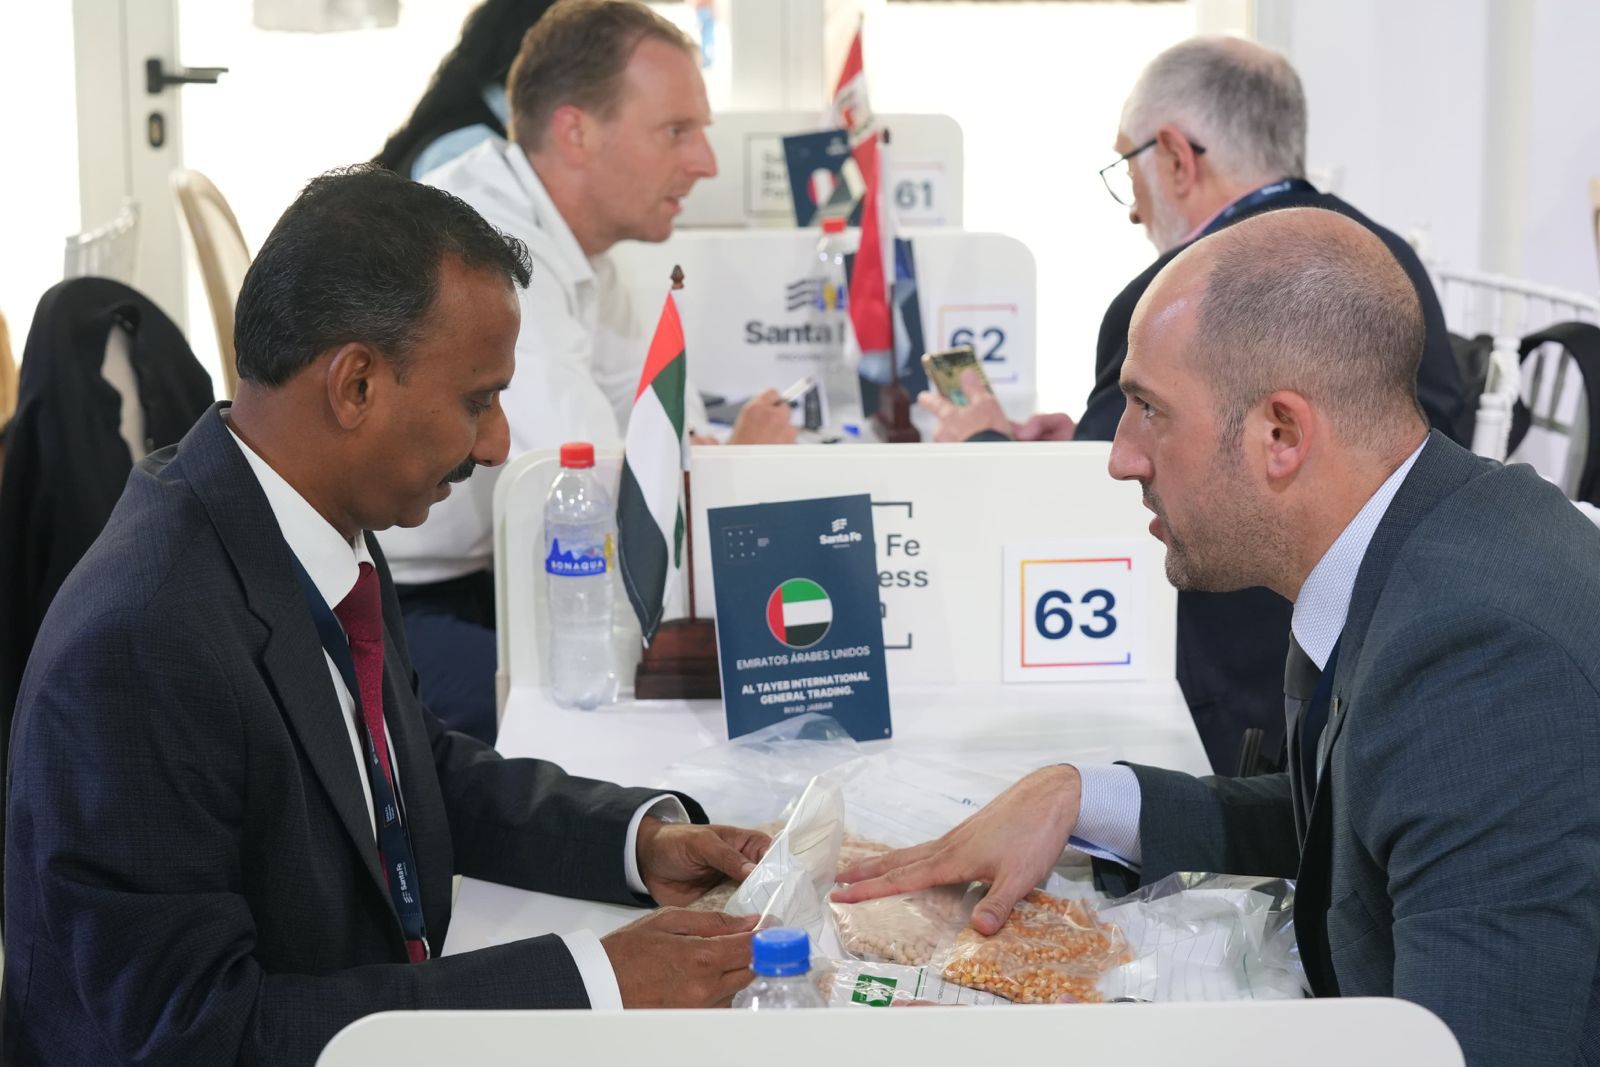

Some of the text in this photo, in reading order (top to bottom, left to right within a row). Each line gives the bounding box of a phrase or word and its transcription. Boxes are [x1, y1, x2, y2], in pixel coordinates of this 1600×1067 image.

[894, 180, 932, 208] 61
[745, 321, 832, 344] Santa
[950, 328, 1005, 361] 62
[819, 531, 862, 545] Santa Fe
[886, 534, 921, 557] Fe
[877, 569, 929, 588] ess
[1034, 588, 1117, 640] 63
[736, 645, 871, 671] EMIRATOS ÁRABES UNIDOS
[742, 684, 755, 695] AL
[791, 671, 870, 689] INTERNATIONAL
[760, 686, 854, 705] GENERAL TRADING.
